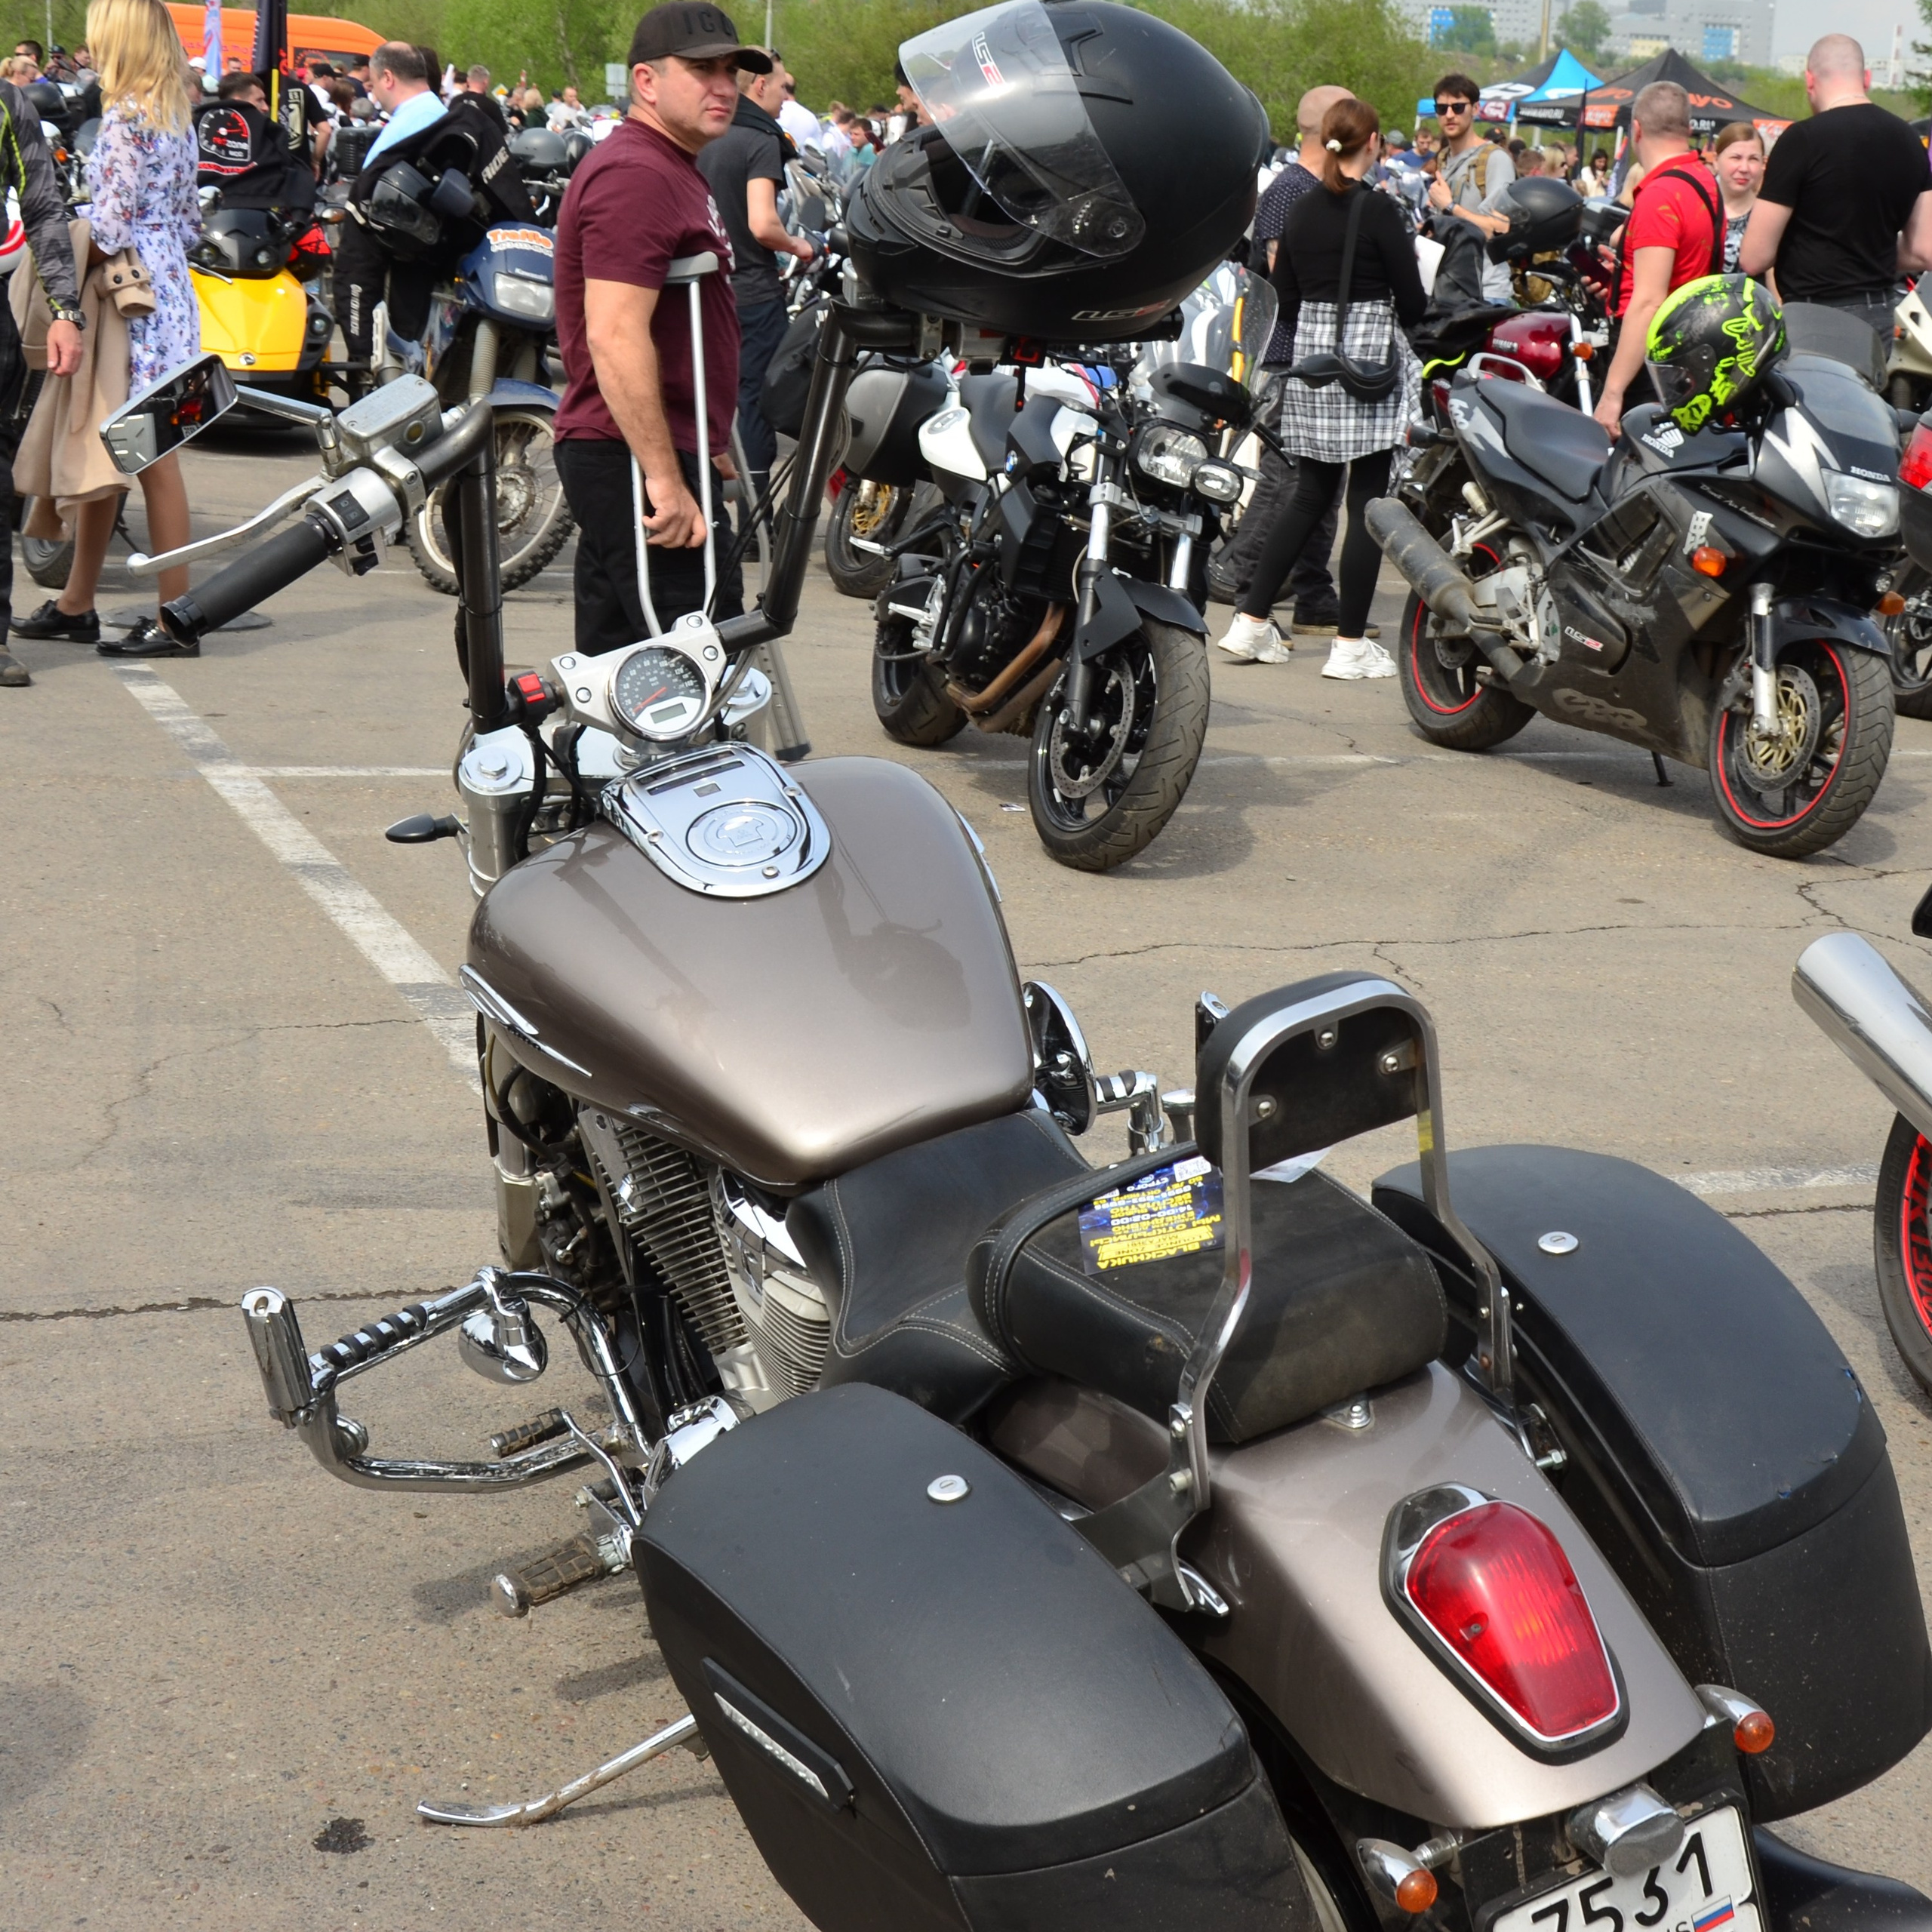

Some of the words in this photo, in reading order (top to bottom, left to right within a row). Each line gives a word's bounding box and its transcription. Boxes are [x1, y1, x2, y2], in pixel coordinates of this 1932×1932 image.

[481, 146, 509, 185] RIDE
[1641, 433, 1675, 459] HONDA
[1850, 466, 1892, 482] HONDA
[1564, 626, 1604, 652] LS2
[1126, 1177, 1168, 1192] СТРОГО
[1110, 1203, 1192, 1226] 14:00-02:00
[1114, 1246, 1145, 1256] ZONE
[1531, 1831, 1713, 1932] 7531
